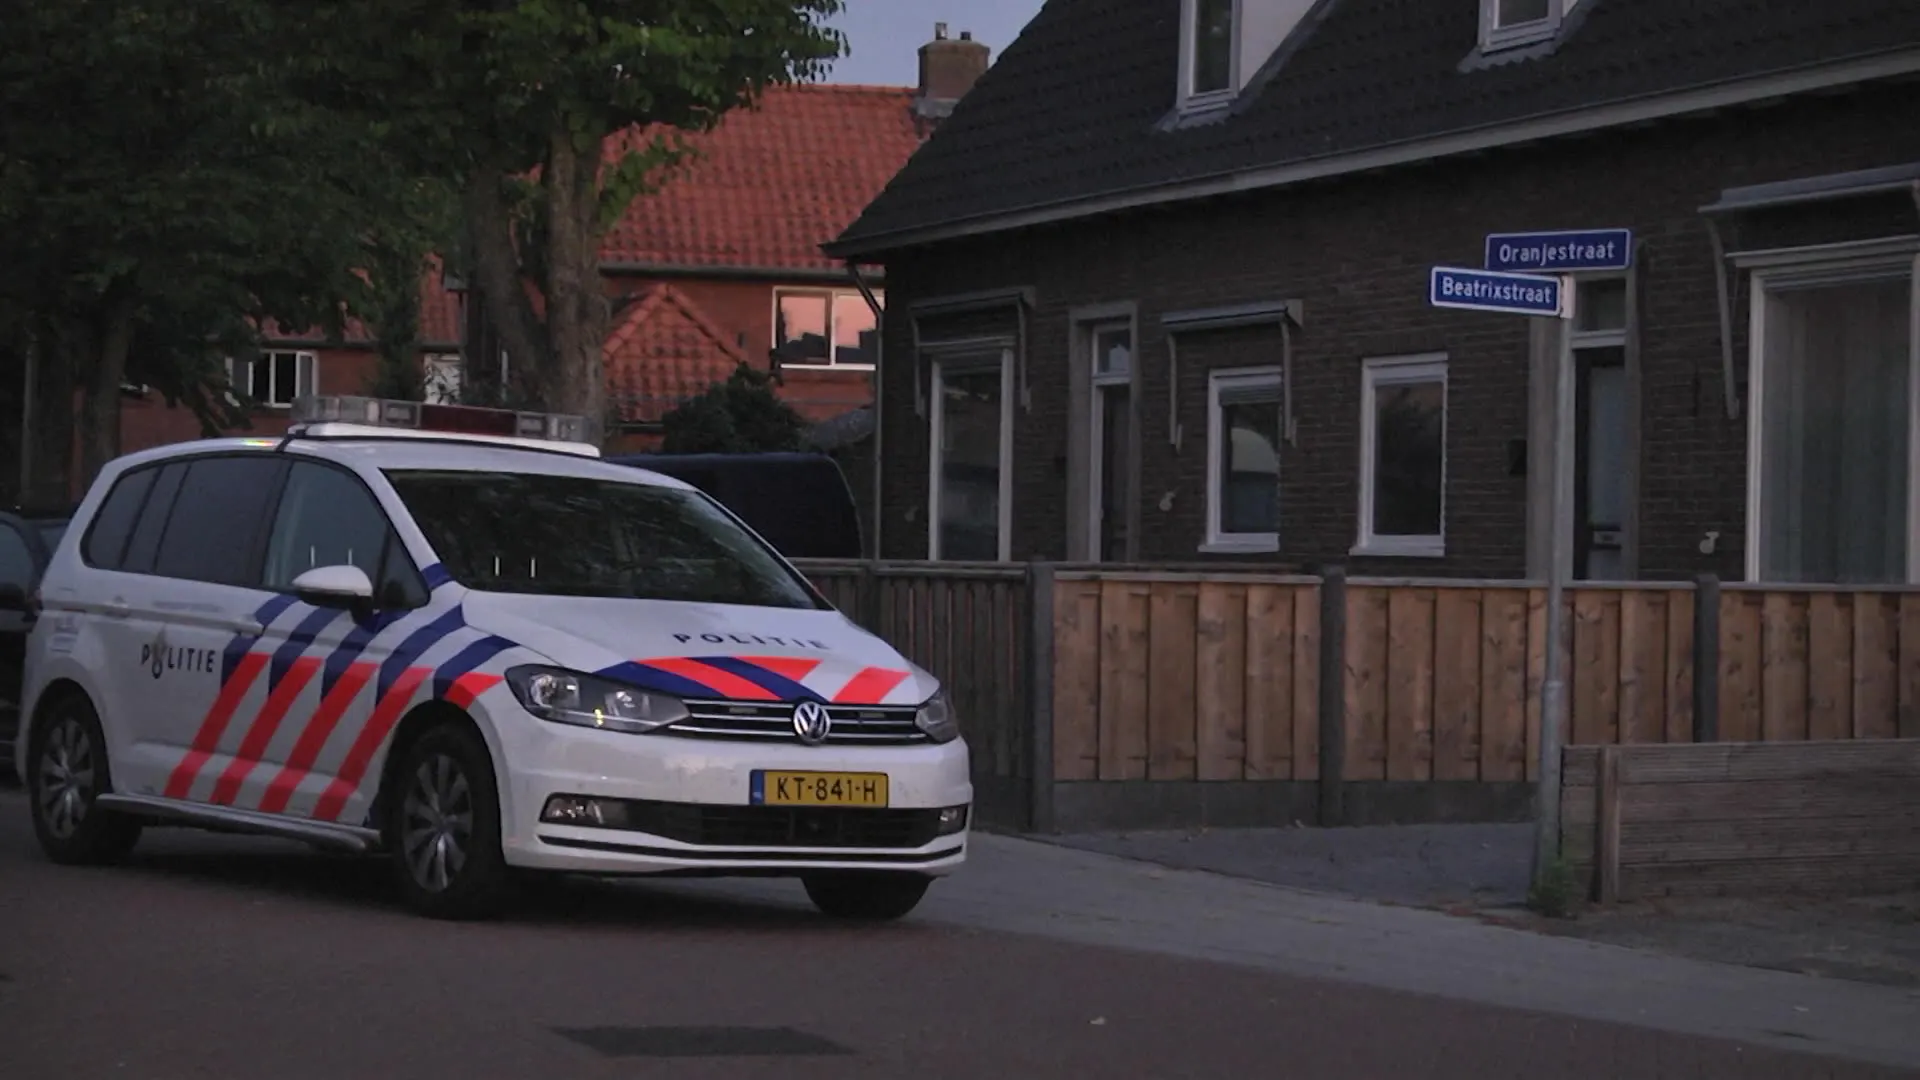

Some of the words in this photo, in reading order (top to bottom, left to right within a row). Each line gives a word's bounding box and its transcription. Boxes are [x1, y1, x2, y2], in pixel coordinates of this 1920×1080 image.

[1499, 241, 1615, 266] Oranjestraat
[1442, 276, 1552, 304] Beatrixstraat
[673, 633, 829, 649] POLITIE
[140, 641, 216, 679] POLITIE
[777, 776, 877, 803] KT-841-H
